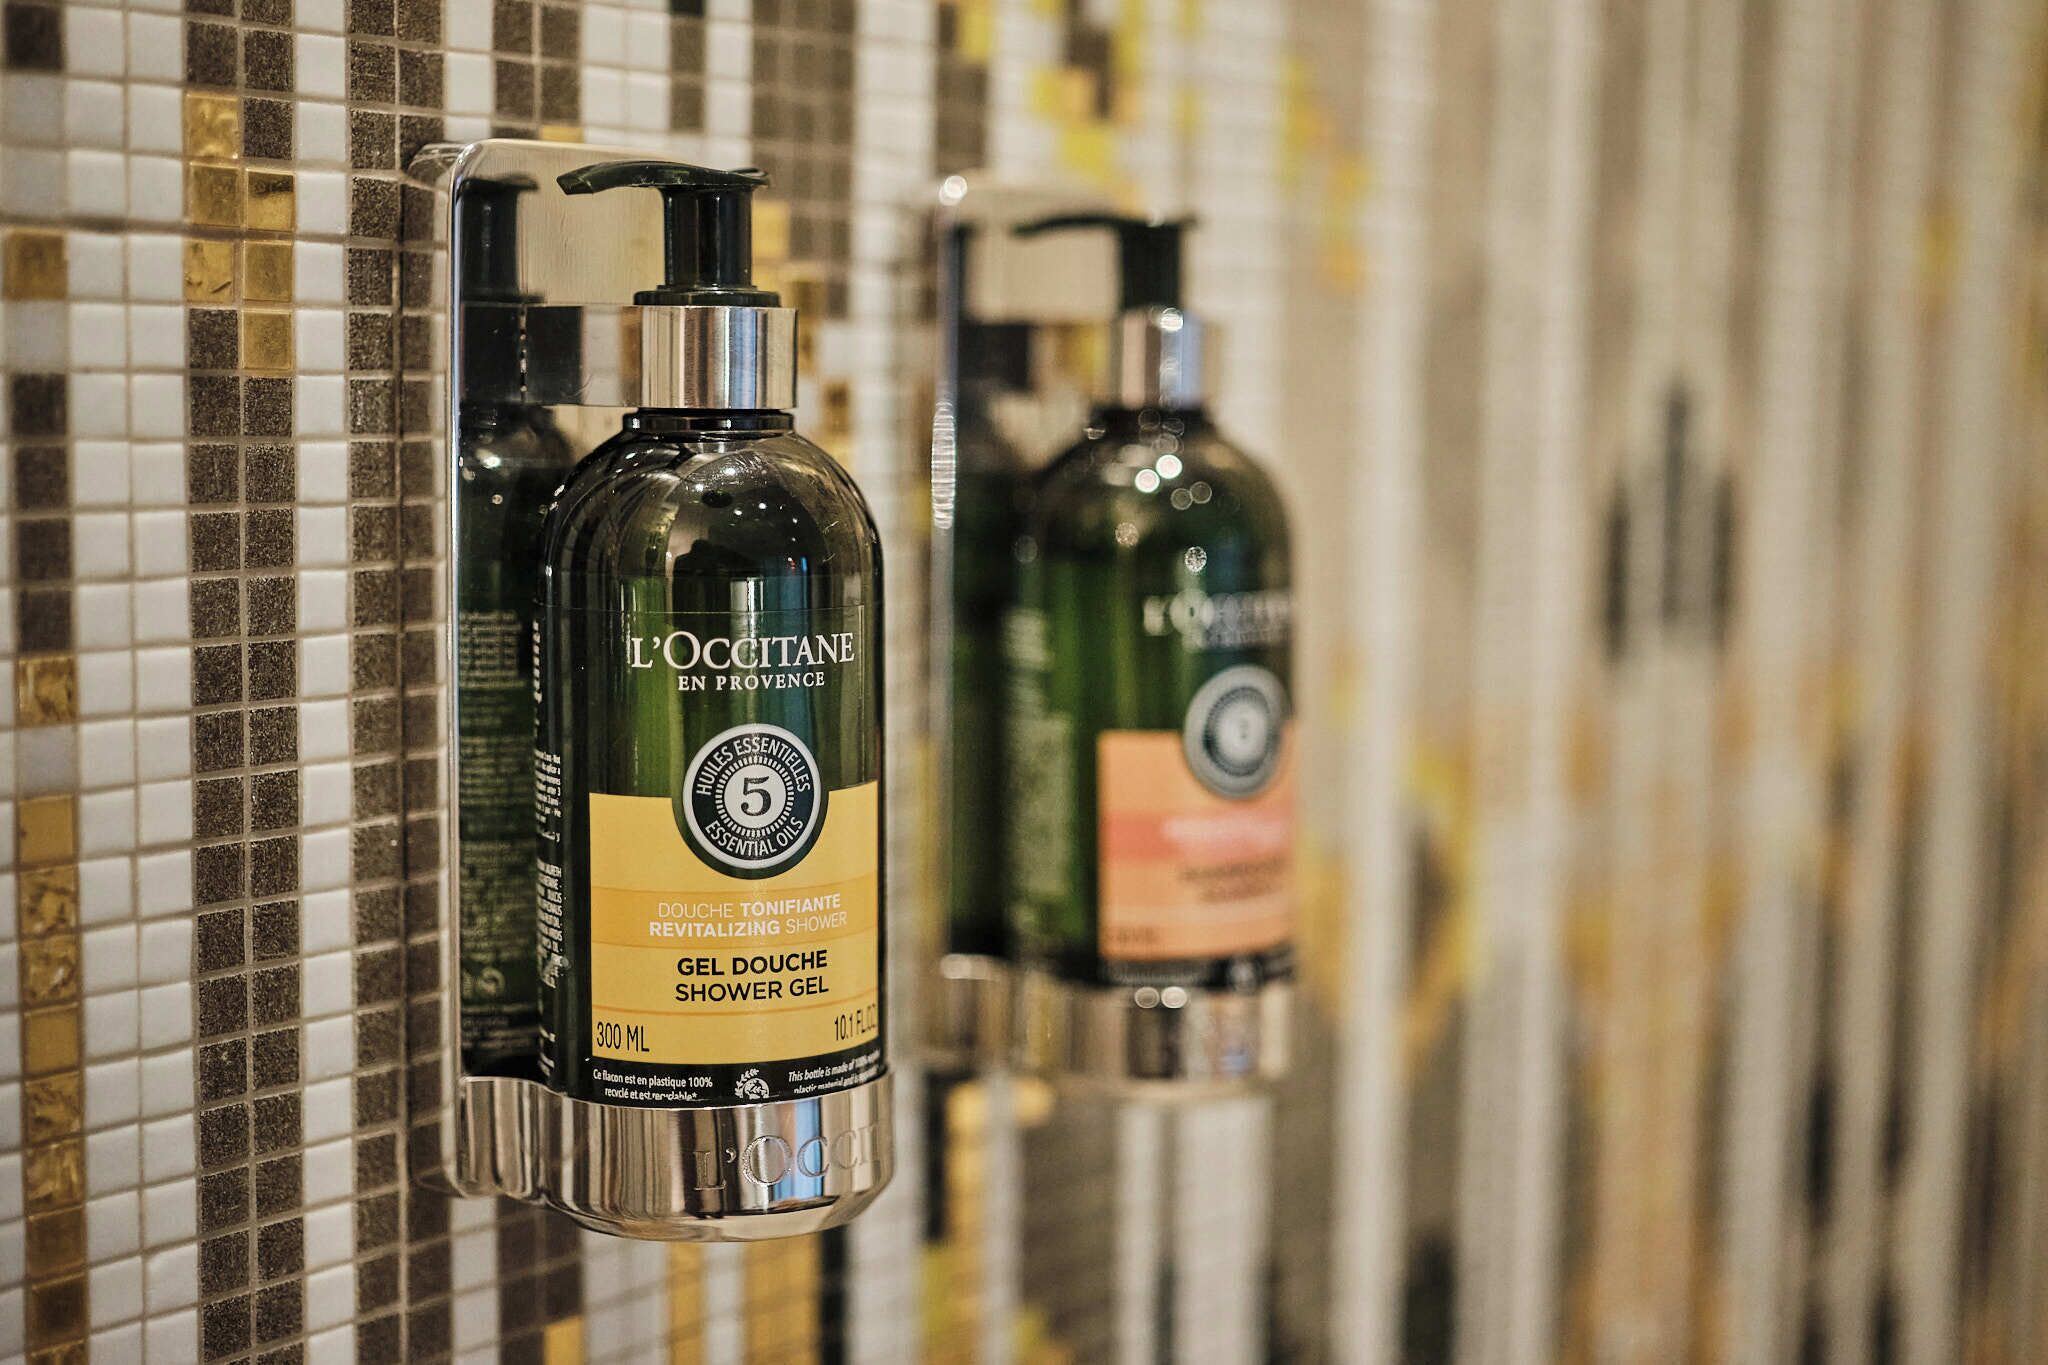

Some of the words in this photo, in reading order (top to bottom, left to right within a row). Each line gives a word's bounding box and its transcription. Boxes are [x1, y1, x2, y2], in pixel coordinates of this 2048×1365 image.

[630, 631, 855, 670] L'OCCITANE
[678, 675, 706, 691] EN
[716, 671, 826, 691] PROVENCE
[696, 746, 733, 795] HUILES
[733, 737, 811, 792] ESSENTIELLES
[741, 776, 772, 817] 5
[705, 820, 777, 857] ESSENTIAL
[776, 816, 804, 847] OILS
[658, 902, 733, 919] DOUCHE
[740, 893, 841, 916] TONIFIANTE
[649, 920, 780, 938] REVITALIZING
[786, 911, 847, 935] SHOWER
[677, 957, 725, 976] GEL
[732, 949, 828, 976] DOUCHE
[675, 980, 782, 1002] SHOWER
[789, 975, 829, 997] GEL
[596, 1021, 622, 1050] 300
[627, 1024, 650, 1053] ML
[834, 1012, 853, 1041] 10.1
[593, 1068, 602, 1080] Ce
[602, 1069, 623, 1083] flacon
[624, 1074, 636, 1085] est
[637, 1075, 647, 1086] en
[648, 1075, 687, 1090] plastique
[688, 1076, 713, 1088] 100%
[788, 1070, 804, 1083] This
[804, 1067, 825, 1081] bottle
[825, 1066, 832, 1077] is
[629, 1090, 638, 1100] et
